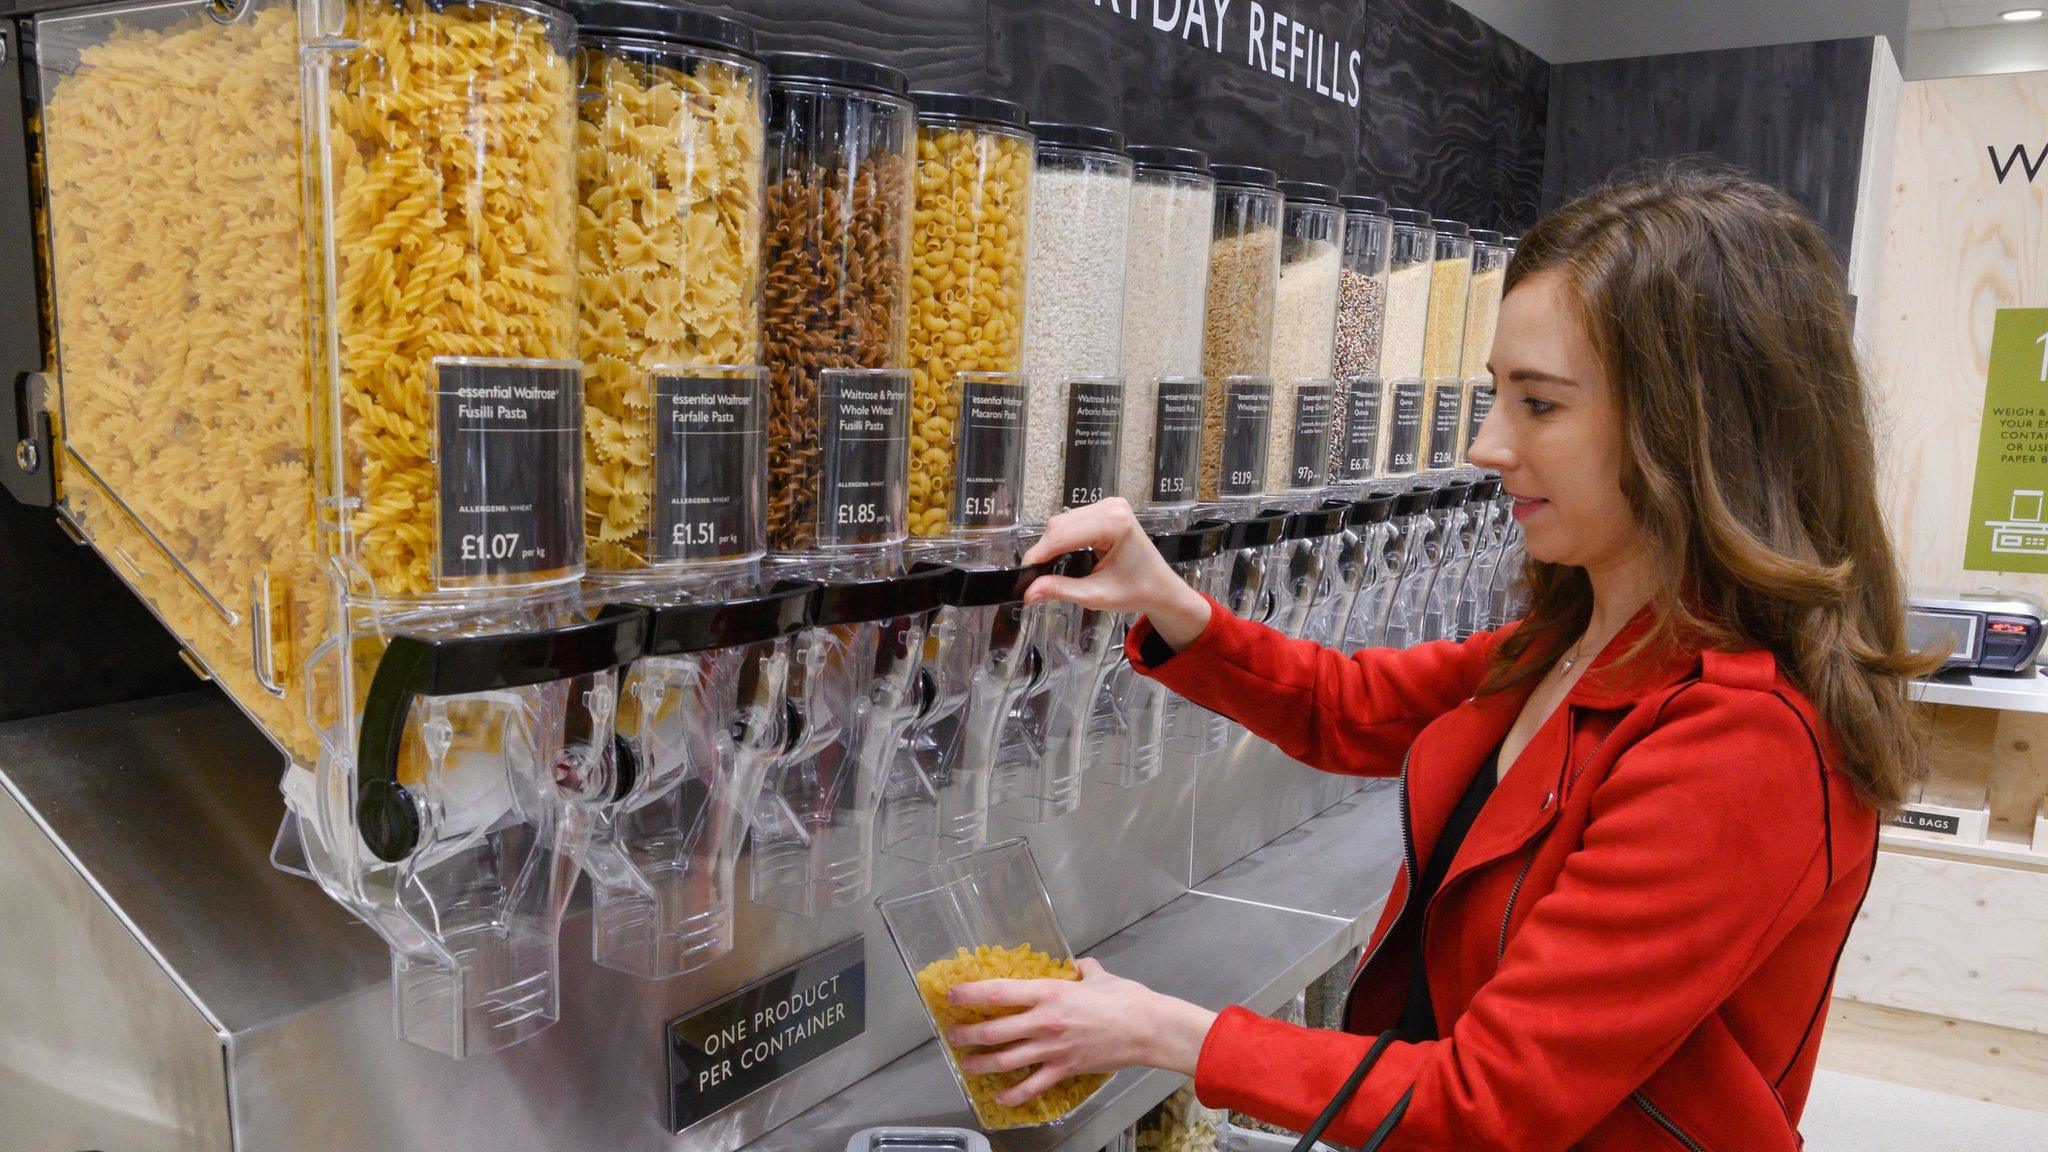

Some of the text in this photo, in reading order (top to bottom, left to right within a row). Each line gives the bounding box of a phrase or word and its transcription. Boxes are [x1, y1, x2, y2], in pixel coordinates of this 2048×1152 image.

[1248, 1, 1361, 108] REFILLS
[458, 385, 512, 399] essential
[841, 388, 878, 400] Waitrose
[879, 389, 885, 400] &
[1078, 393, 1105, 404] Waitrose
[672, 393, 715, 406] essential
[972, 395, 1002, 405] essential
[458, 404, 527, 420] Fusilli Pasta
[672, 410, 734, 423] Farfalle Pasta
[840, 404, 894, 416] Whole Wheat
[971, 408, 1003, 419] Macaroni
[1077, 406, 1101, 416] Arborio
[1993, 408, 2046, 416] WEIGH &
[840, 419, 884, 431] Fusilli Pasta
[2000, 420, 2033, 428] YOUR
[2007, 443, 2023, 452] OR
[2001, 455, 2035, 463] PAPER
[1298, 466, 1313, 481] 97p
[1160, 477, 1184, 493] £1.53
[1072, 487, 1103, 504] £2.63
[459, 504, 532, 513] ALLERGENS: WHEAT
[965, 497, 995, 515] £1.51
[838, 504, 875, 524] £1.85
[672, 522, 714, 545] £1.51
[719, 535, 728, 545] per
[461, 533, 545, 560] £1.07 per kg
[1919, 817, 1949, 829] BAGS
[705, 974, 840, 1056] ONE PRODUCT
[699, 1002, 845, 1093] PER CONTAINER
